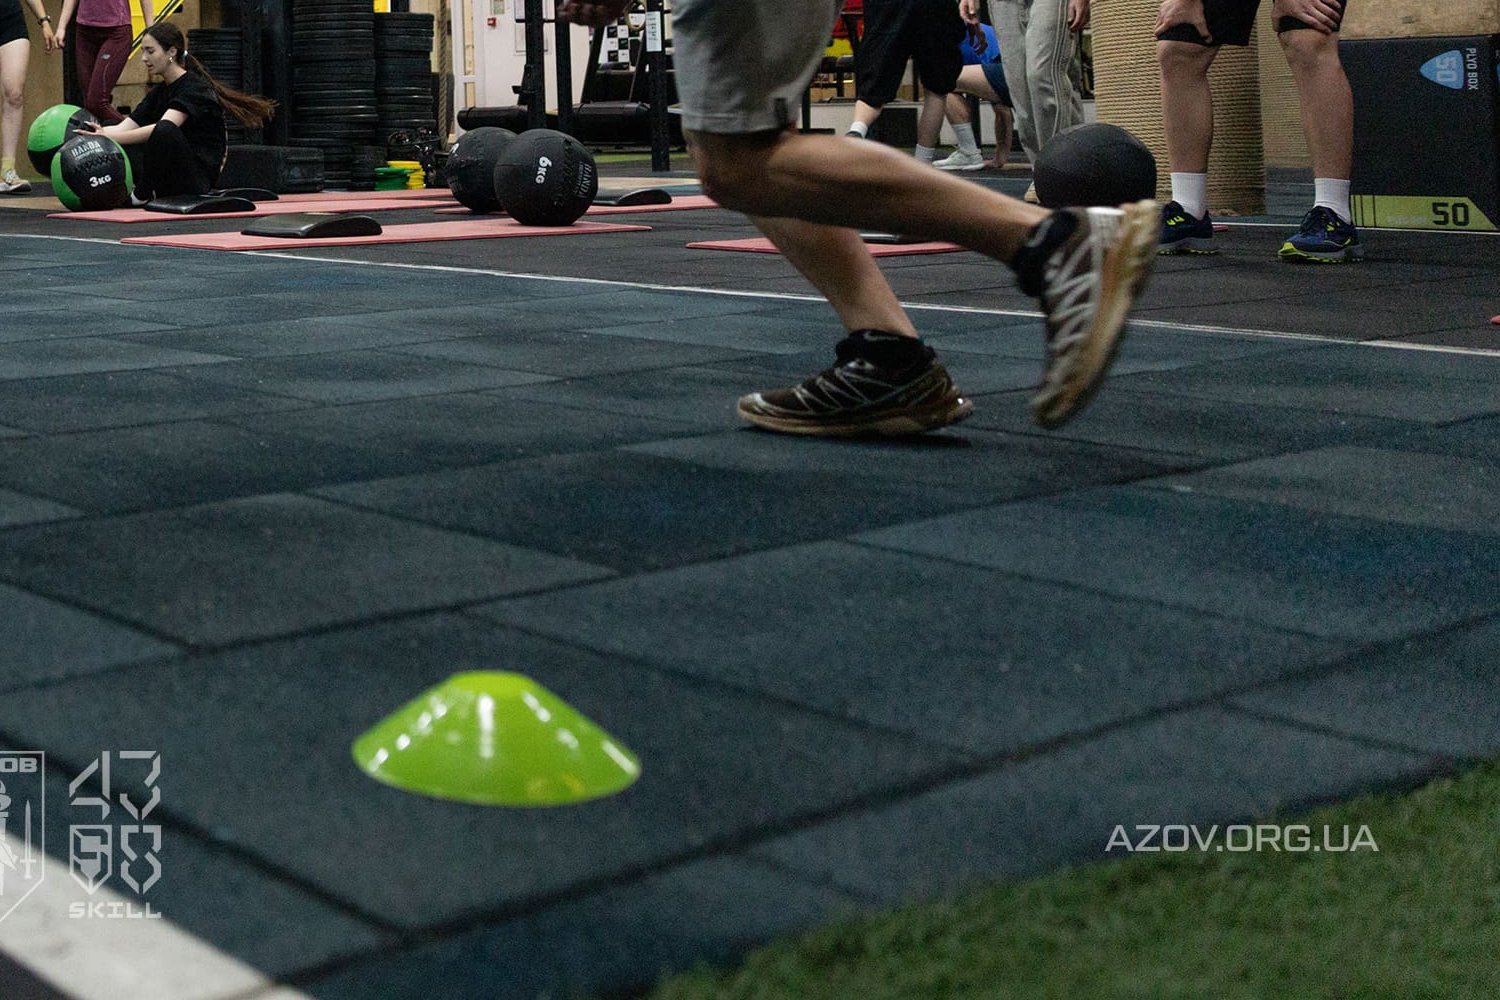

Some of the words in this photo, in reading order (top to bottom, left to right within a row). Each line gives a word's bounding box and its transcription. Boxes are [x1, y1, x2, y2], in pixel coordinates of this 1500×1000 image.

[1435, 56, 1458, 83] 50
[1465, 47, 1477, 69] PLYO
[1467, 71, 1479, 91] BOX
[89, 174, 112, 188] 3KG
[535, 156, 552, 184] 6KG
[1432, 202, 1470, 227] 50
